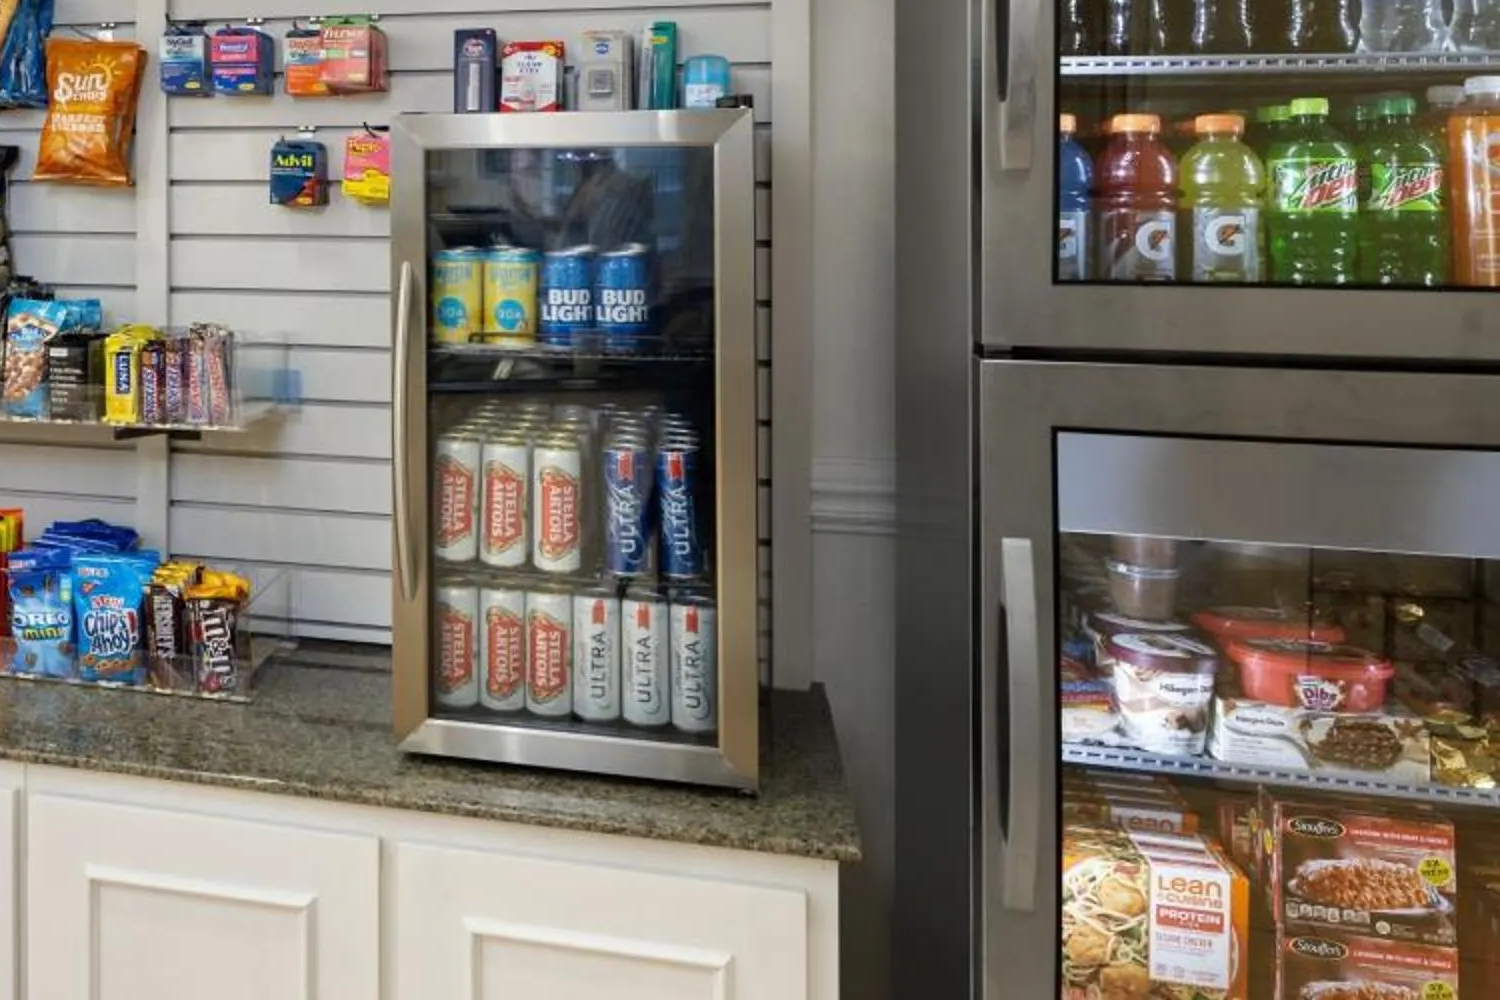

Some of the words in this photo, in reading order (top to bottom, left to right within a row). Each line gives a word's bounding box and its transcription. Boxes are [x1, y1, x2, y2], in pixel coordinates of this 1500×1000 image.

[274, 153, 314, 168] Advil
[541, 304, 592, 322] LIGHT
[547, 289, 590, 305] BUD
[596, 304, 648, 322] LIGHT
[603, 289, 645, 305] BUD
[454, 475, 466, 532] STELLA
[508, 480, 518, 537] STELLA
[562, 485, 574, 542] STELLA
[618, 484, 636, 553] ULTRA
[674, 484, 691, 555] ULTRA
[12, 611, 69, 627] OREO
[84, 609, 127, 637] Chips
[452, 622, 465, 677] STELLA
[495, 626, 509, 683] ARTOIS
[509, 626, 521, 682] STELLA
[533, 629, 548, 688] ARTOIS
[549, 631, 561, 687] STELLA
[590, 631, 606, 700] ULTRA
[637, 636, 653, 704] ULTRA
[685, 640, 701, 710] ULTRA
[1157, 875, 1222, 898] Lean
[1159, 907, 1222, 926] PROTEIN
